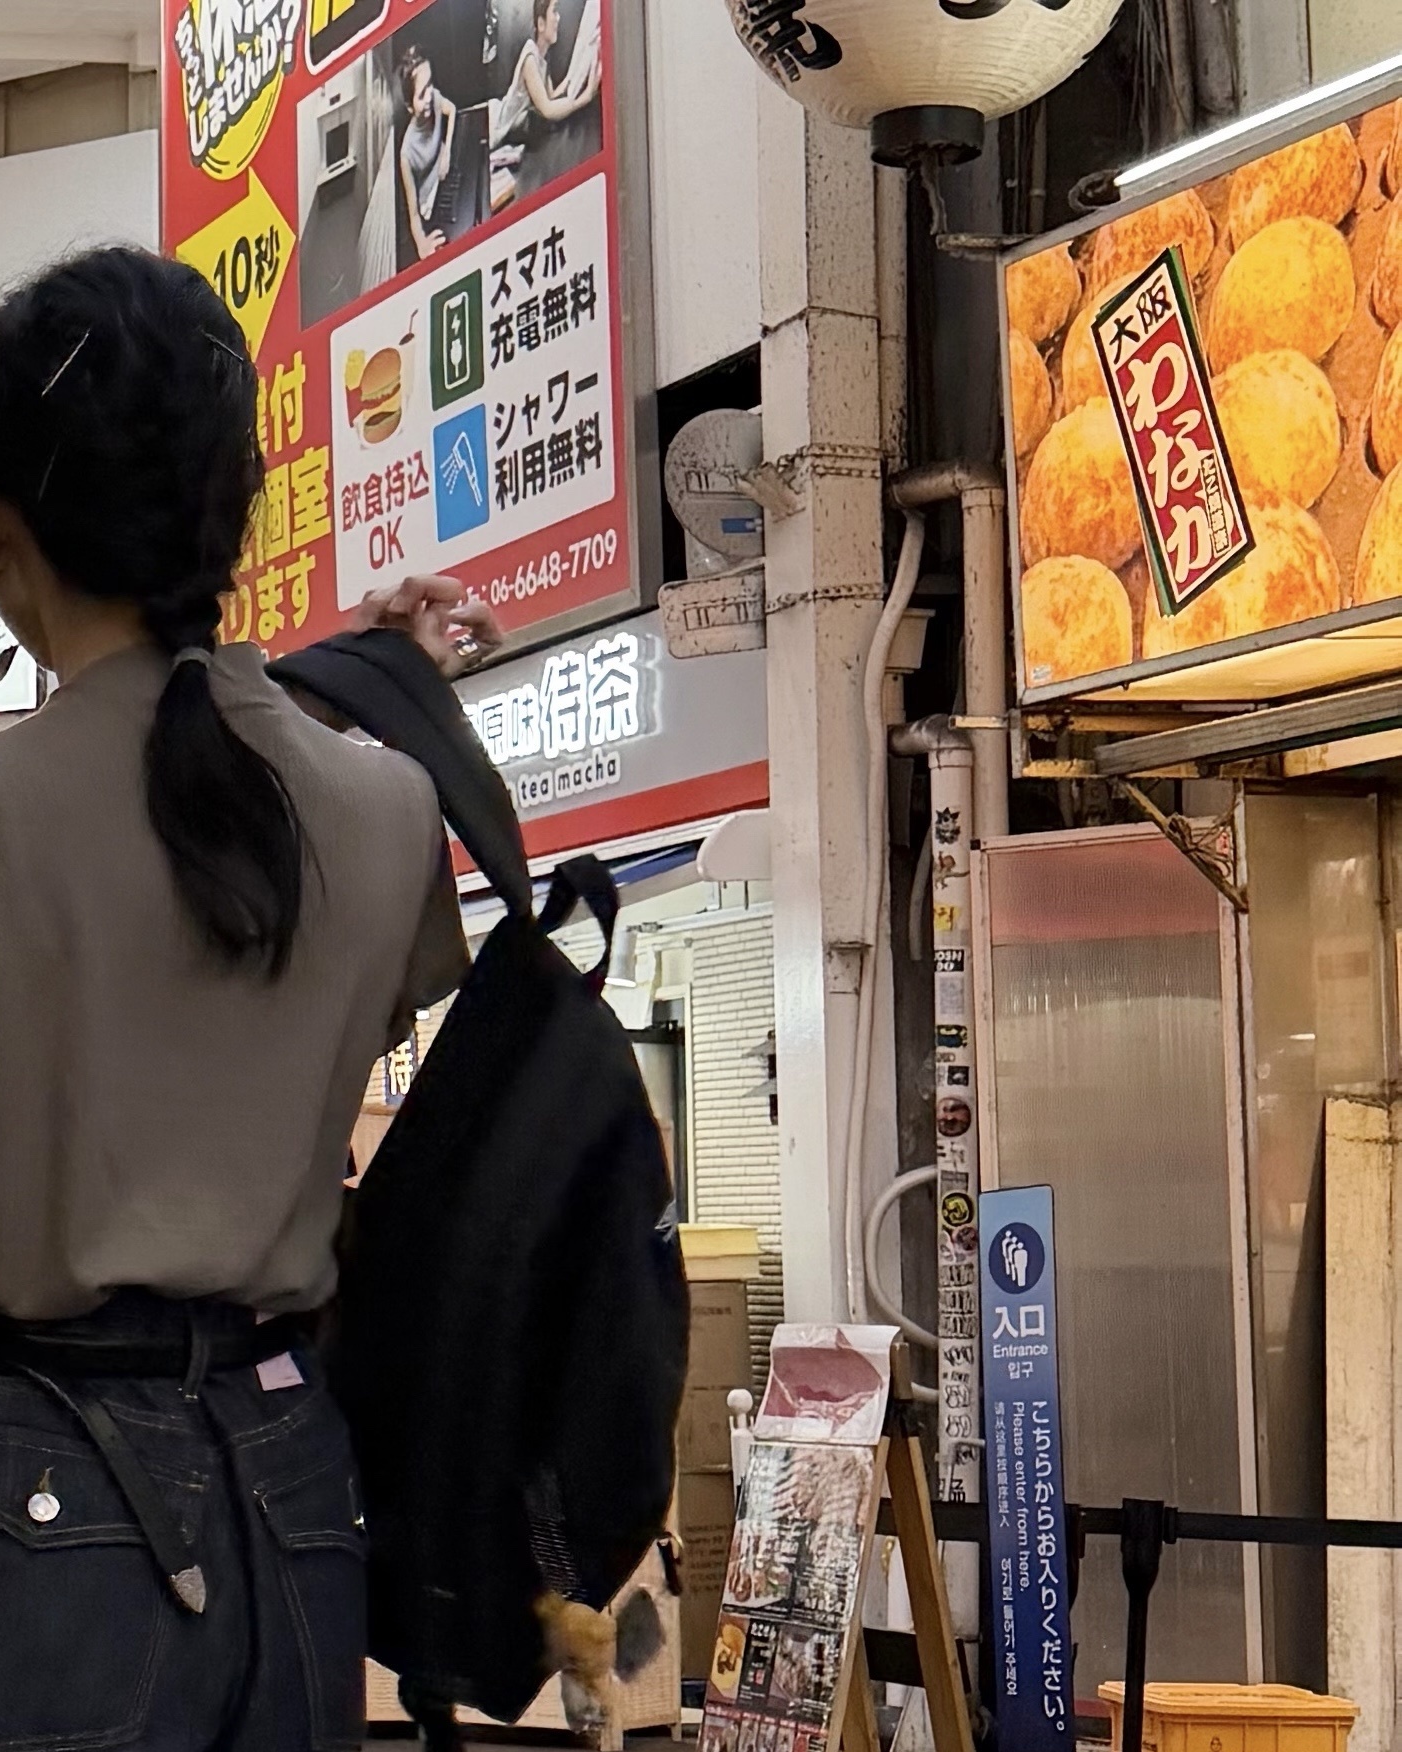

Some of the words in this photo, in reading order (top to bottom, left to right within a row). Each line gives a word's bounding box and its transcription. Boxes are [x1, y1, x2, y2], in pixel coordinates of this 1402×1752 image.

[213, 224, 280, 310] 10秒
[489, 225, 567, 309] スマホ
[490, 263, 597, 371] 充電無料
[1108, 274, 1173, 366] 大阪
[493, 369, 599, 451] シャワー
[340, 450, 430, 533] 飲食持込
[494, 411, 603, 511] 利用無料
[1125, 341, 1234, 584] わなか
[368, 514, 405, 571] OK
[490, 528, 618, 606] 06-6648-7709
[216, 551, 316, 646] ります
[519, 776, 550, 802] tea
[557, 755, 618, 793] macha
[991, 1303, 1046, 1340] 入口
[992, 1343, 1048, 1359] Entrance
[1007, 1361, 1034, 1379] 입구
[1012, 1401, 1025, 1456] Please
[1014, 1460, 1027, 1504] enter
[1016, 1508, 1029, 1546] from
[1031, 1400, 1065, 1732] こちらからお入りください。
[1018, 1550, 1030, 1592] here.
